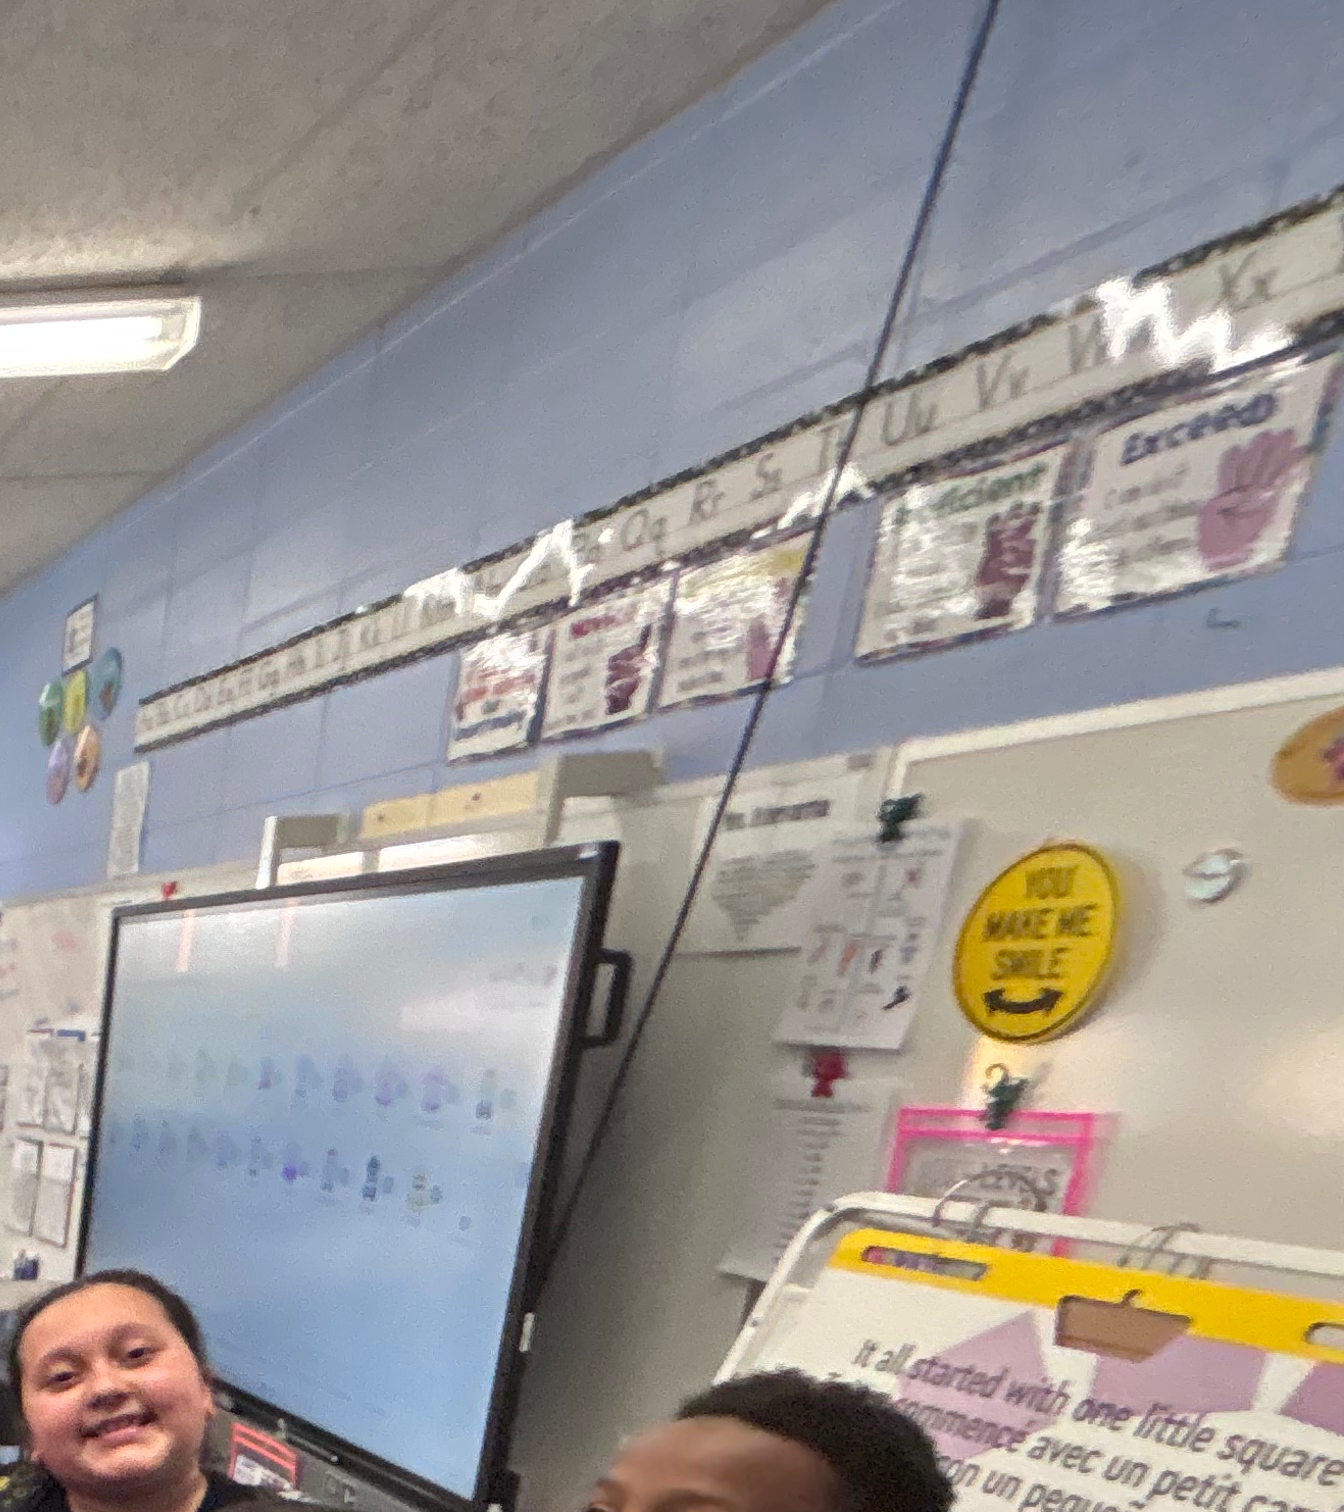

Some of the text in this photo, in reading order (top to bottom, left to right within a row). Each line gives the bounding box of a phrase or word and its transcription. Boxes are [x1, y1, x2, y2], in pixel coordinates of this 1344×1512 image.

[1025, 864, 1079, 899] YOU
[980, 902, 1099, 943] MAKE ME
[990, 947, 1070, 981] SMILE
[908, 1356, 1009, 1398] started
[1006, 1377, 1070, 1417] with
[1072, 1398, 1132, 1431] one
[1133, 1402, 1216, 1452] little
[1217, 1434, 1344, 1486] square
[982, 1468, 1023, 1501] un
[1027, 1436, 1103, 1473] avec
[1103, 1455, 1150, 1487] un
[1145, 1469, 1243, 1512] petit
